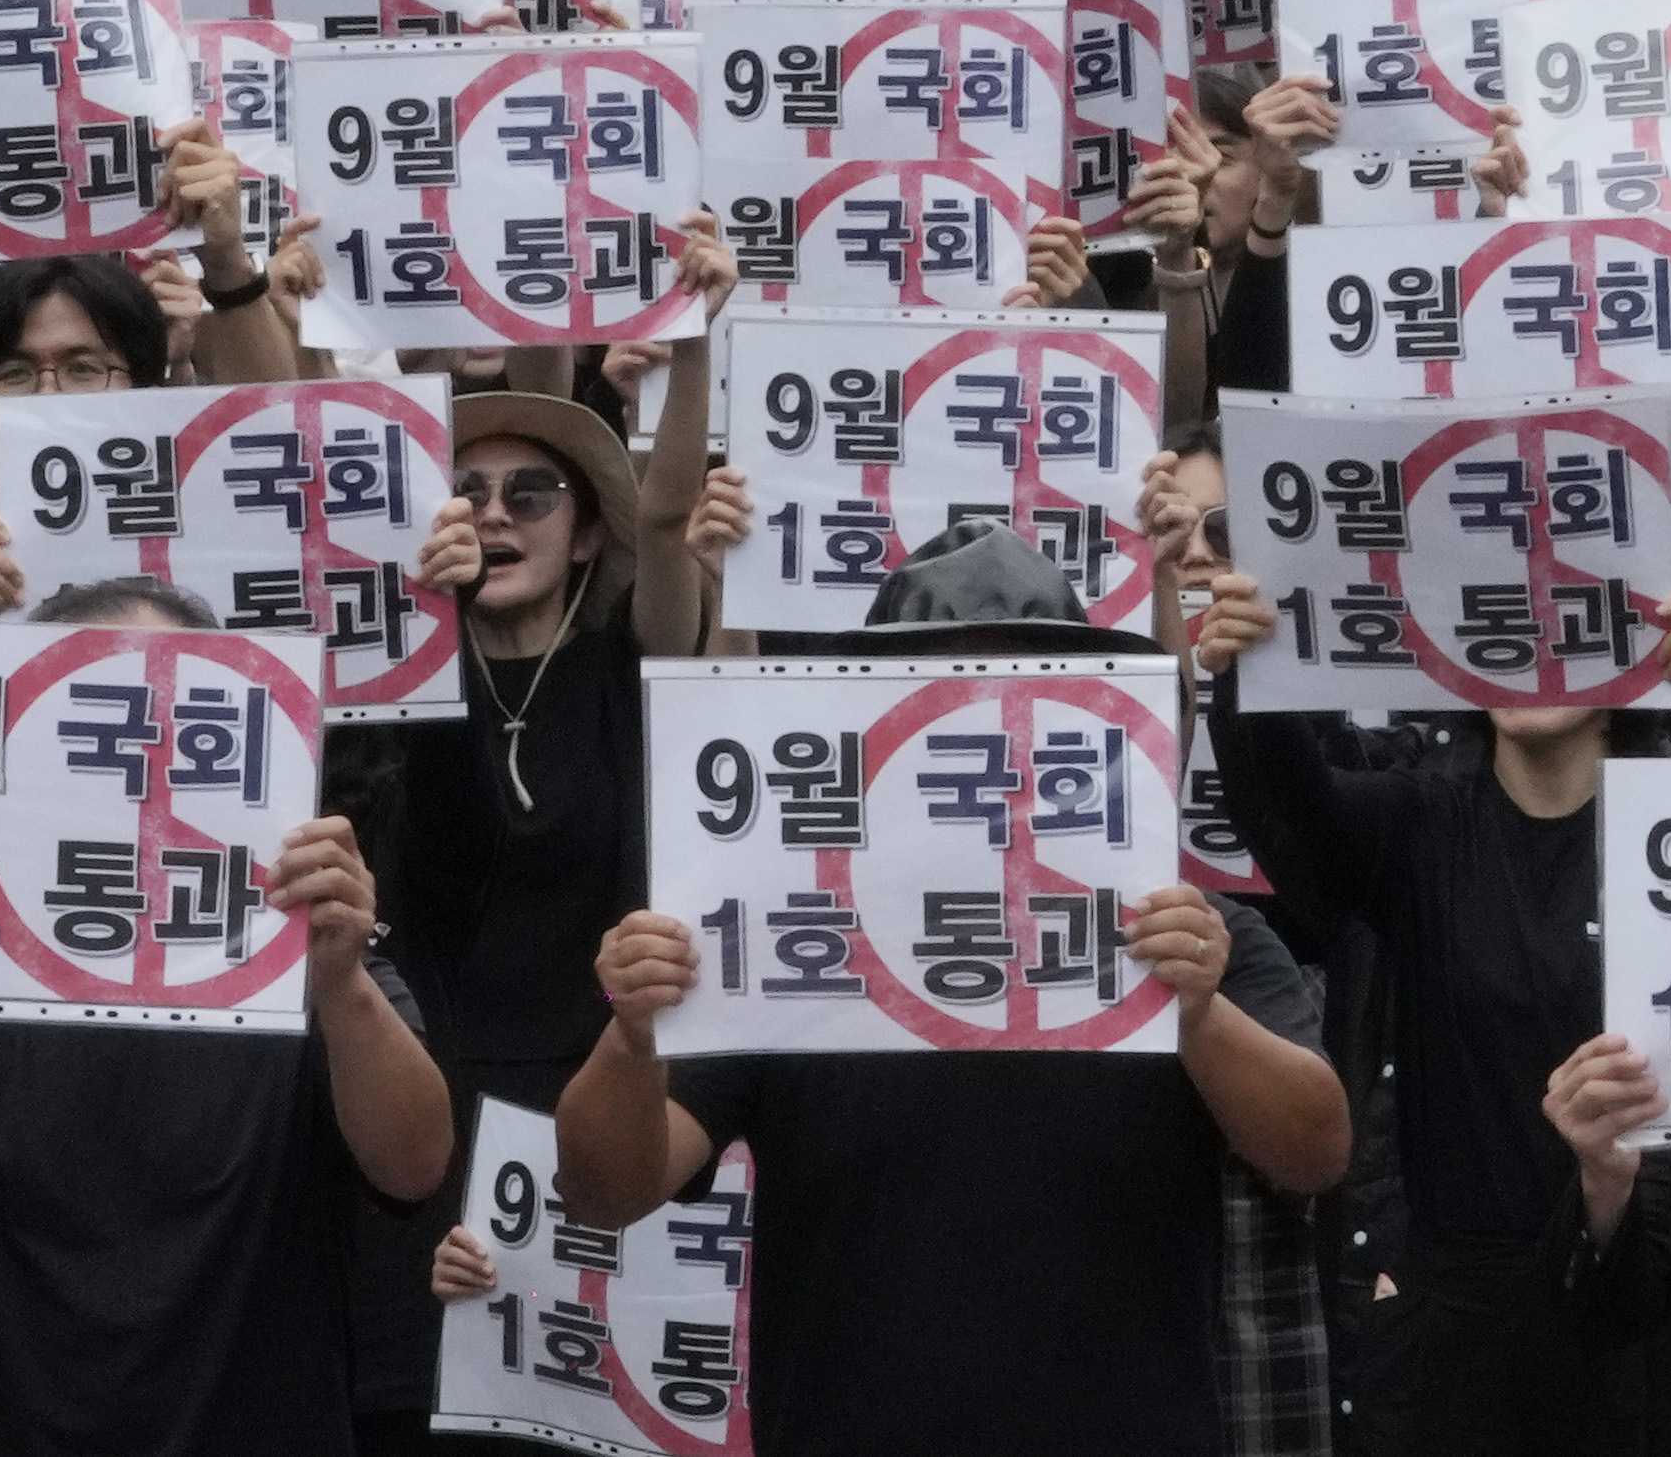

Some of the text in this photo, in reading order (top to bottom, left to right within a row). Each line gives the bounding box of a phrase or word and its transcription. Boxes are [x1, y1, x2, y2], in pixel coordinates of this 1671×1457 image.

[1535, 28, 1671, 120] 9월
[328, 89, 664, 188] 9월 국회
[334, 212, 670, 309] 1호 통과
[1325, 263, 1465, 362] 9월
[765, 367, 1118, 471] 9월 국회
[29, 424, 409, 534] 9월 국회
[1260, 449, 1634, 551] 9월 국회
[764, 499, 889, 589] 1호
[1277, 577, 1642, 676] 1호 통과
[56, 681, 271, 802] 국회
[693, 727, 1129, 849] 9월 국회
[42, 838, 263, 959] 통과
[701, 888, 1126, 1003] 1호 통과
